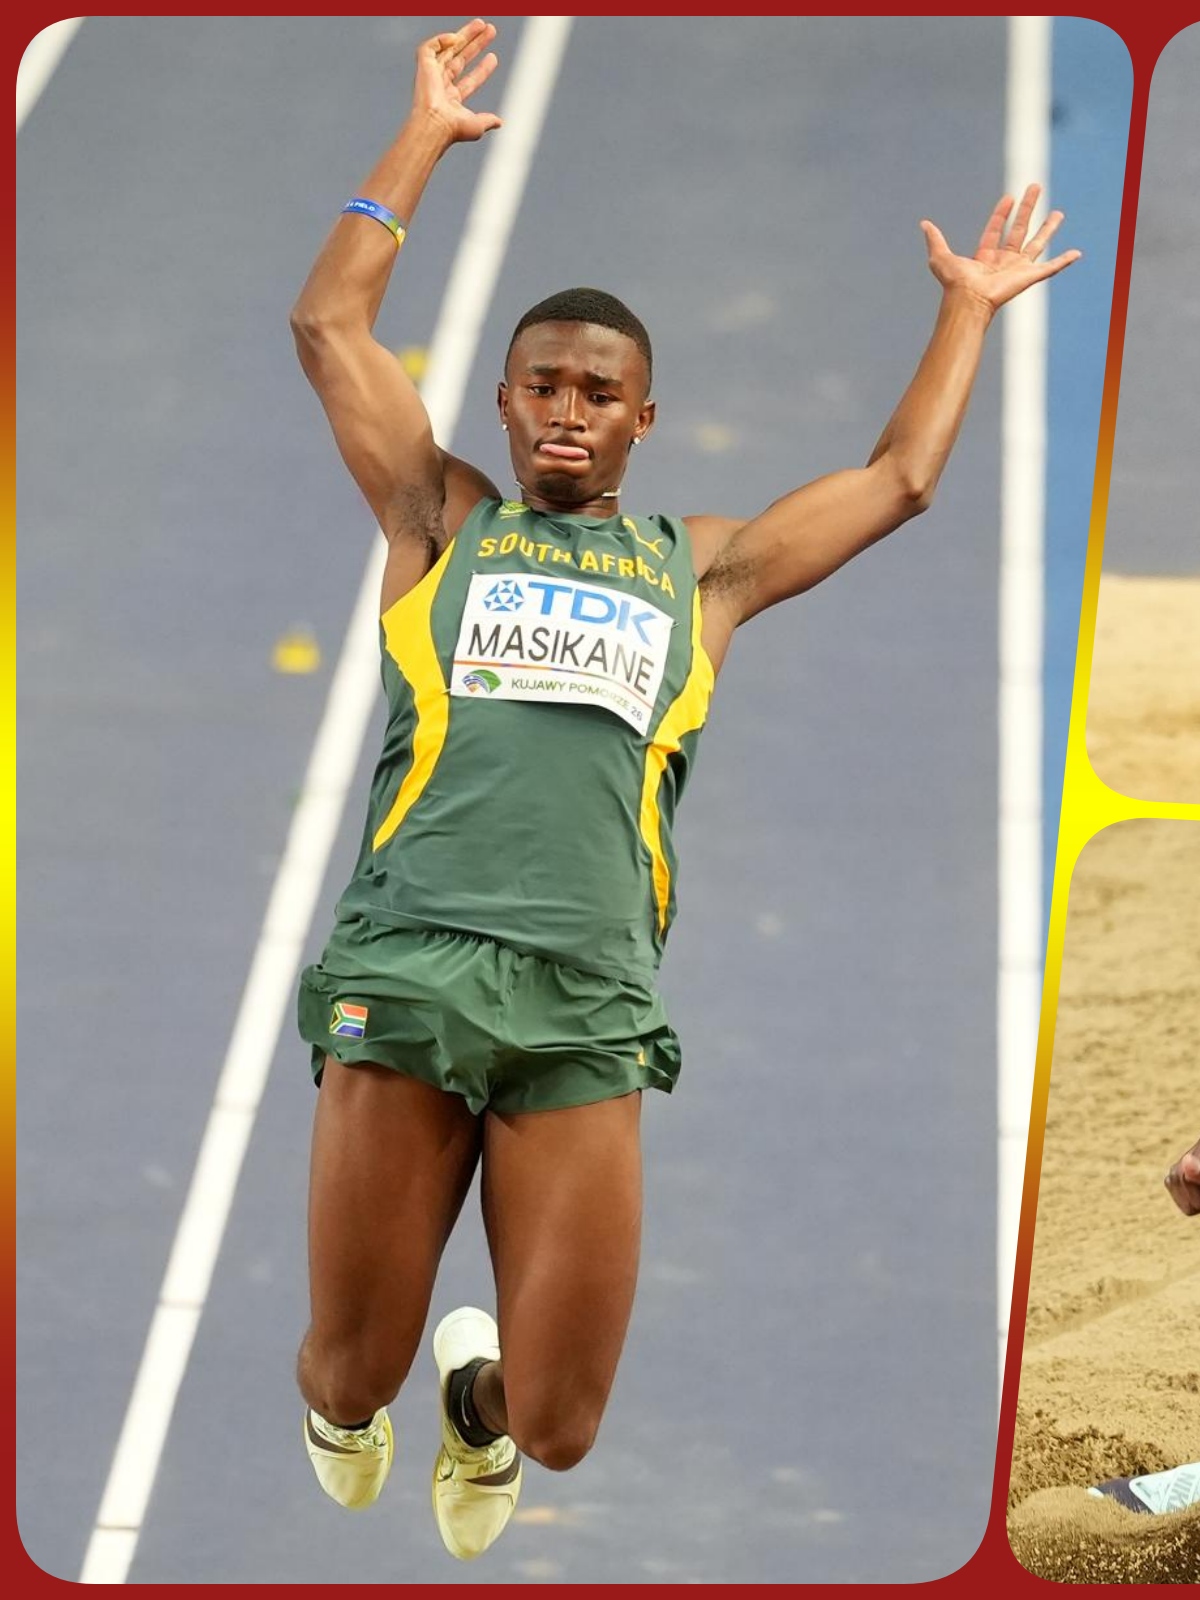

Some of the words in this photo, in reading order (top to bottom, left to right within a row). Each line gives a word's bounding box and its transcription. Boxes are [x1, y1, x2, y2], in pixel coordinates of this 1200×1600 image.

[477, 532, 571, 565] SOUTH
[579, 551, 675, 600] AFRICA
[528, 581, 657, 647] TDK
[467, 623, 655, 696] MASIKANE
[511, 678, 566, 691] KUJAWY
[631, 706, 643, 721] 26
